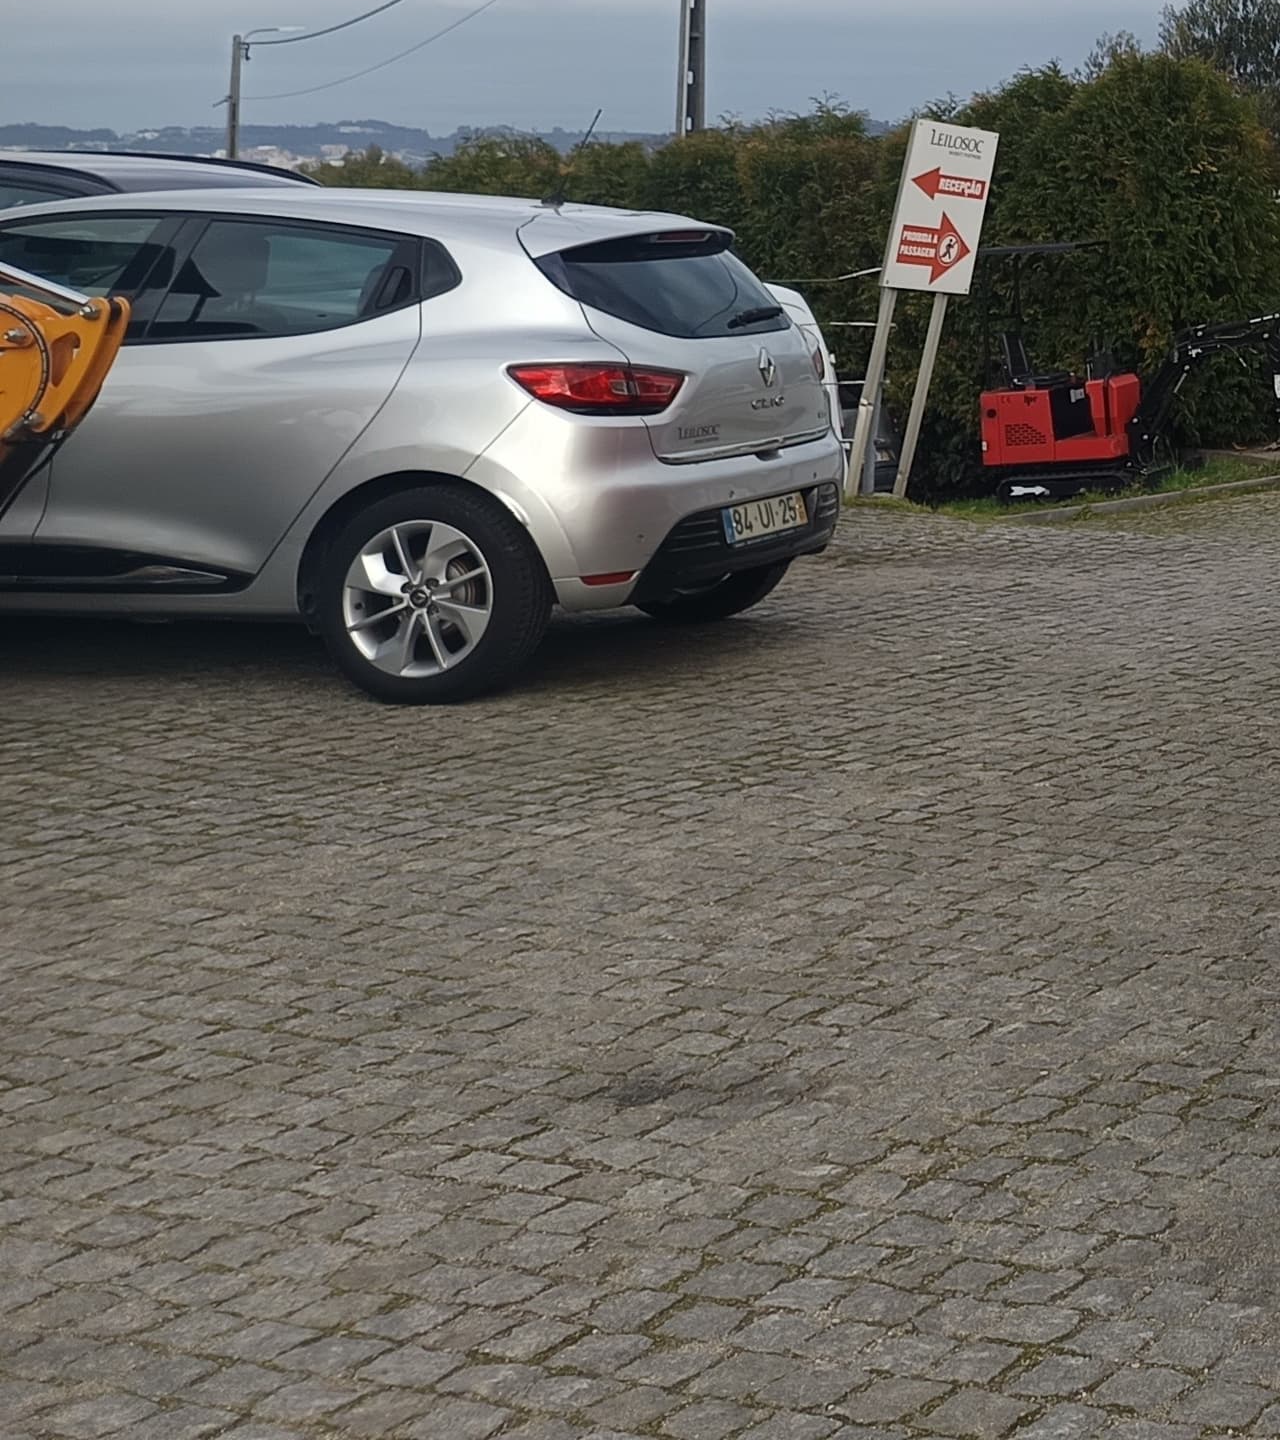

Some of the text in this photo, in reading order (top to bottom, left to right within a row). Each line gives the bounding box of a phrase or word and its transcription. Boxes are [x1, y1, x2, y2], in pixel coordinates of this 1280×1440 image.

[930, 128, 985, 154] LEILOSOC
[938, 176, 983, 197] RECEPÇÃO
[751, 395, 785, 410] CLIO
